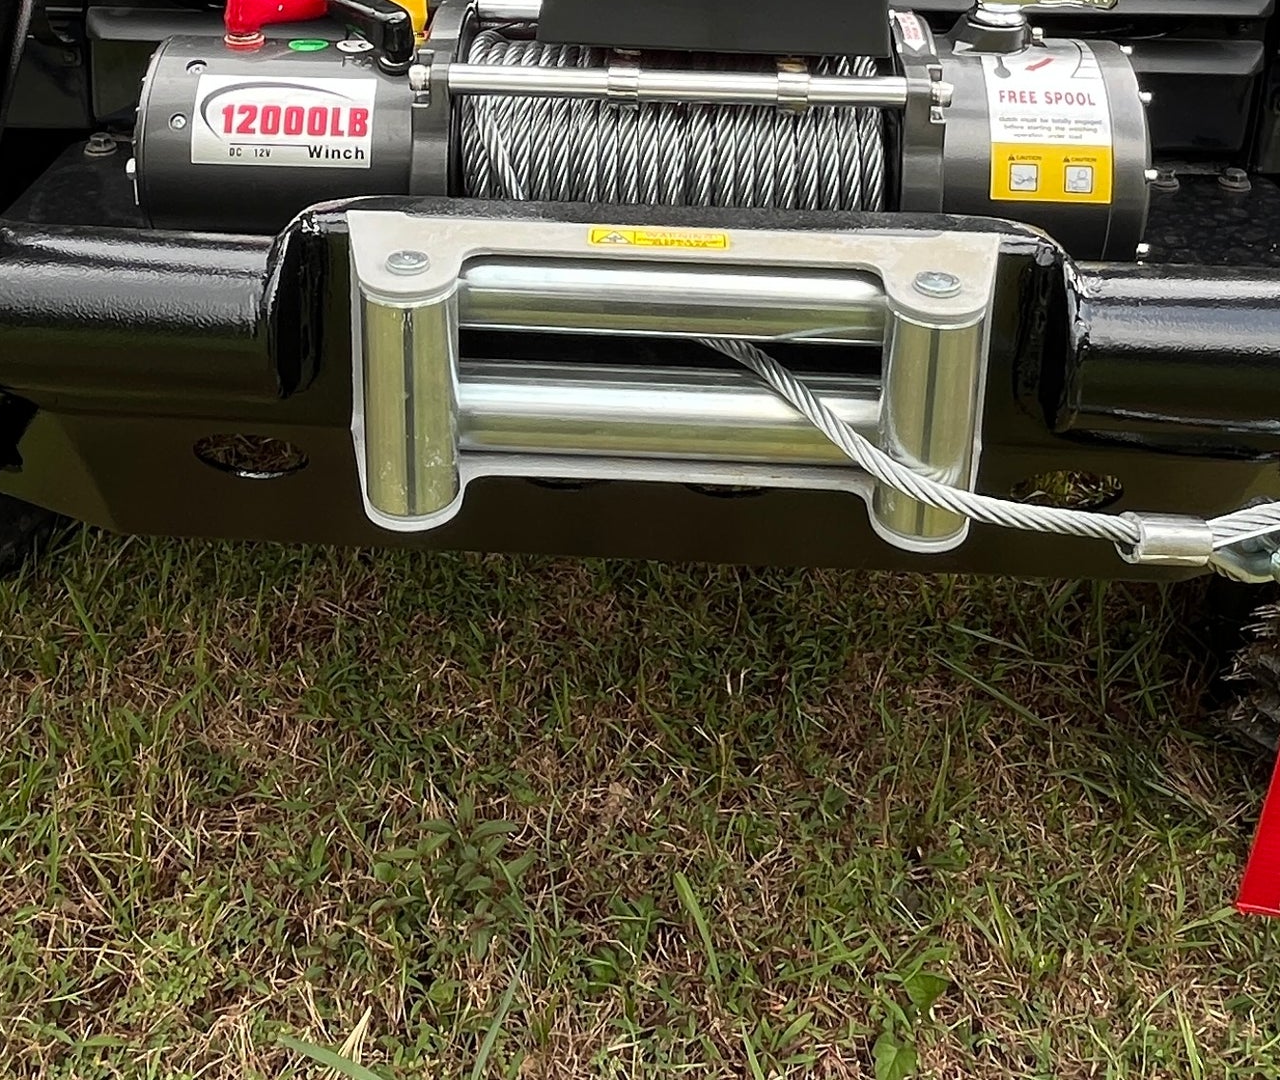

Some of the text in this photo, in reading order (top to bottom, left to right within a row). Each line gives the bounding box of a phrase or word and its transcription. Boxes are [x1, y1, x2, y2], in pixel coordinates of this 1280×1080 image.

[999, 89, 1096, 106] FREE SPOOL
[222, 104, 369, 138] 12000LB
[229, 147, 271, 157] DC 12V
[308, 145, 365, 160] Winch
